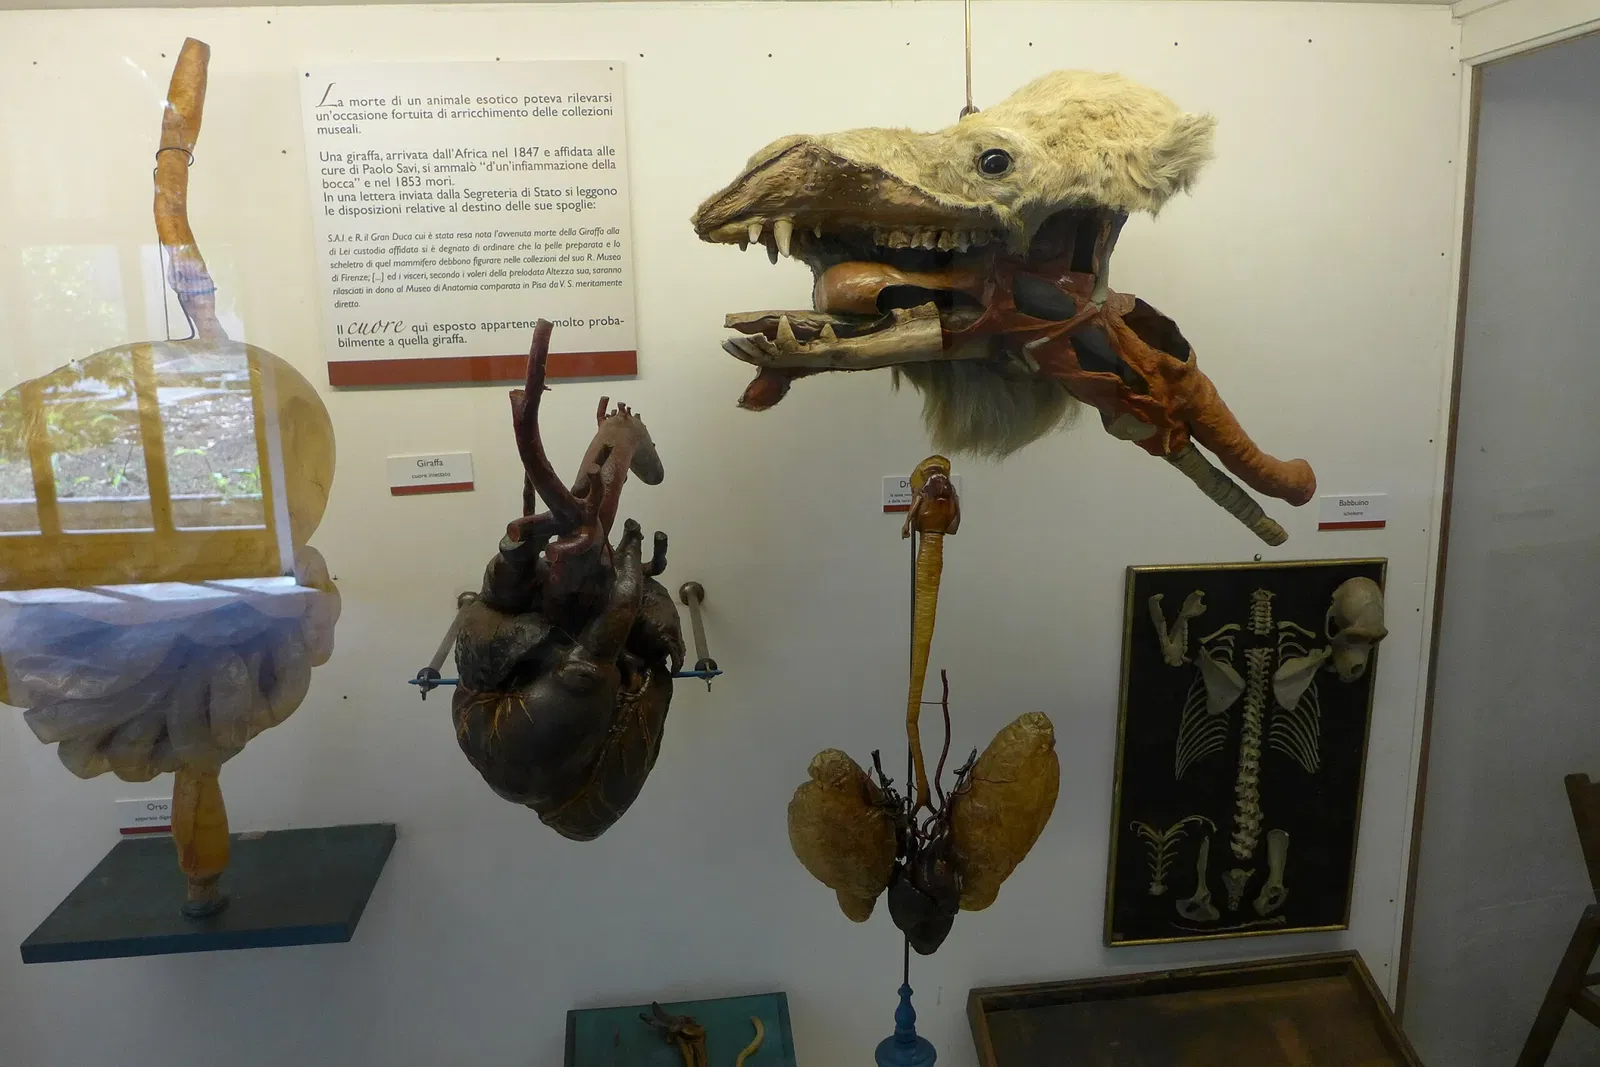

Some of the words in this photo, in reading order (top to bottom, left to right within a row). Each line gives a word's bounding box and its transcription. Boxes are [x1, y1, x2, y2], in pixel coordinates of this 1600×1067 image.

[315, 82, 344, 108] La
[349, 98, 386, 107] morte
[391, 95, 402, 106] di
[407, 98, 421, 106] un
[426, 94, 471, 106] animale
[476, 94, 519, 105] esotico
[524, 95, 562, 106] poteva
[568, 92, 612, 103] rilevarsi
[316, 110, 388, 121] un'occasione
[391, 109, 433, 120] fortuita
[437, 108, 447, 119] di
[450, 107, 529, 118] arricchimento
[532, 106, 558, 117] delle
[562, 106, 613, 117] collezioni
[317, 123, 361, 135] museali.
[319, 151, 343, 162] Una
[346, 150, 383, 164] giraffa,
[386, 150, 429, 160] arrivata
[492, 147, 508, 158] nel
[514, 146, 539, 158] 1847
[544, 149, 551, 157] e
[554, 146, 593, 157] affidata
[597, 145, 615, 156] alle
[321, 167, 346, 176] cure
[349, 163, 359, 175] di
[362, 163, 393, 174] Paolo
[396, 163, 420, 176] Savi,
[422, 163, 431, 173] si
[434, 161, 477, 173] ammalò
[592, 159, 616, 170] della
[364, 180, 371, 188] e
[374, 177, 391, 188] nel
[396, 176, 421, 187] 1853
[324, 191, 334, 202] In
[337, 194, 357, 202] una
[360, 191, 396, 202] lettera
[399, 190, 433, 200] inviata
[436, 189, 461, 200] dalla
[464, 188, 518, 201] Segreteria
[521, 187, 531, 198] di
[534, 186, 562, 198] Stato
[565, 187, 573, 197] si
[576, 187, 617, 199] leggono
[324, 205, 335, 216] le
[338, 204, 402, 218] disposizioni
[406, 203, 445, 214] relative
[449, 202, 458, 213] al
[462, 202, 502, 212] destino
[505, 200, 531, 211] delle
[534, 203, 553, 211] sue
[556, 200, 596, 212] spoglie:
[364, 233, 369, 241] il
[370, 233, 390, 241] Gran
[392, 232, 413, 241] Duca
[414, 232, 426, 241] cui
[428, 232, 433, 240] è
[435, 232, 454, 240] stata
[558, 228, 577, 236] della
[578, 227, 605, 237] Giraffa
[606, 227, 620, 235] alla
[328, 248, 337, 256] di
[339, 248, 351, 256] Lei
[353, 246, 386, 255] custodia
[388, 245, 419, 255] affidata
[430, 245, 435, 253] è
[438, 244, 470, 254] degnato
[472, 244, 480, 252] di
[482, 243, 515, 251] ordinare
[517, 242, 531, 251] che
[534, 242, 541, 250] la
[544, 241, 563, 252] pelle
[565, 241, 603, 251] preparata
[614, 239, 621, 248] lo
[366, 260, 373, 268] di
[375, 259, 391, 270] quel
[393, 258, 437, 267] mammifero
[438, 257, 471, 266] debbono
[473, 256, 501, 267] figurare
[504, 255, 521, 264] nelle
[522, 255, 557, 263] collezioni
[558, 254, 570, 262] del
[596, 253, 621, 261] Museo
[332, 274, 339, 282] di
[341, 273, 371, 282] Firenze;
[387, 272, 397, 281] ed
[403, 272, 428, 280] visceri,
[430, 270, 460, 279] secondo
[466, 269, 487, 278] voleri
[489, 269, 507, 277] della
[509, 268, 545, 278] prelodata
[546, 267, 574, 276] Altezza
[333, 287, 364, 295] rilasciati
[375, 285, 394, 294] dono
[396, 285, 403, 293] al
[405, 284, 431, 293] Museo
[433, 284, 441, 292] di
[480, 283, 521, 292] comparata
[532, 281, 547, 289] Pisa
[548, 280, 559, 289] da
[567, 279, 574, 288] S.
[334, 300, 360, 308] diretto.
[337, 324, 343, 335] Il
[347, 319, 407, 335] cuore
[411, 322, 428, 334] qui
[432, 323, 477, 334] esposto
[480, 320, 539, 333] appartene
[552, 317, 585, 327] molto
[588, 316, 625, 328] proba-
[338, 337, 385, 348] bilmente
[388, 338, 395, 346] a
[398, 335, 429, 348] quella
[432, 334, 467, 347] giraffa.
[416, 458, 444, 468] Giraffa
[1339, 499, 1369, 507] Babbuino
[147, 803, 168, 811] Orso
